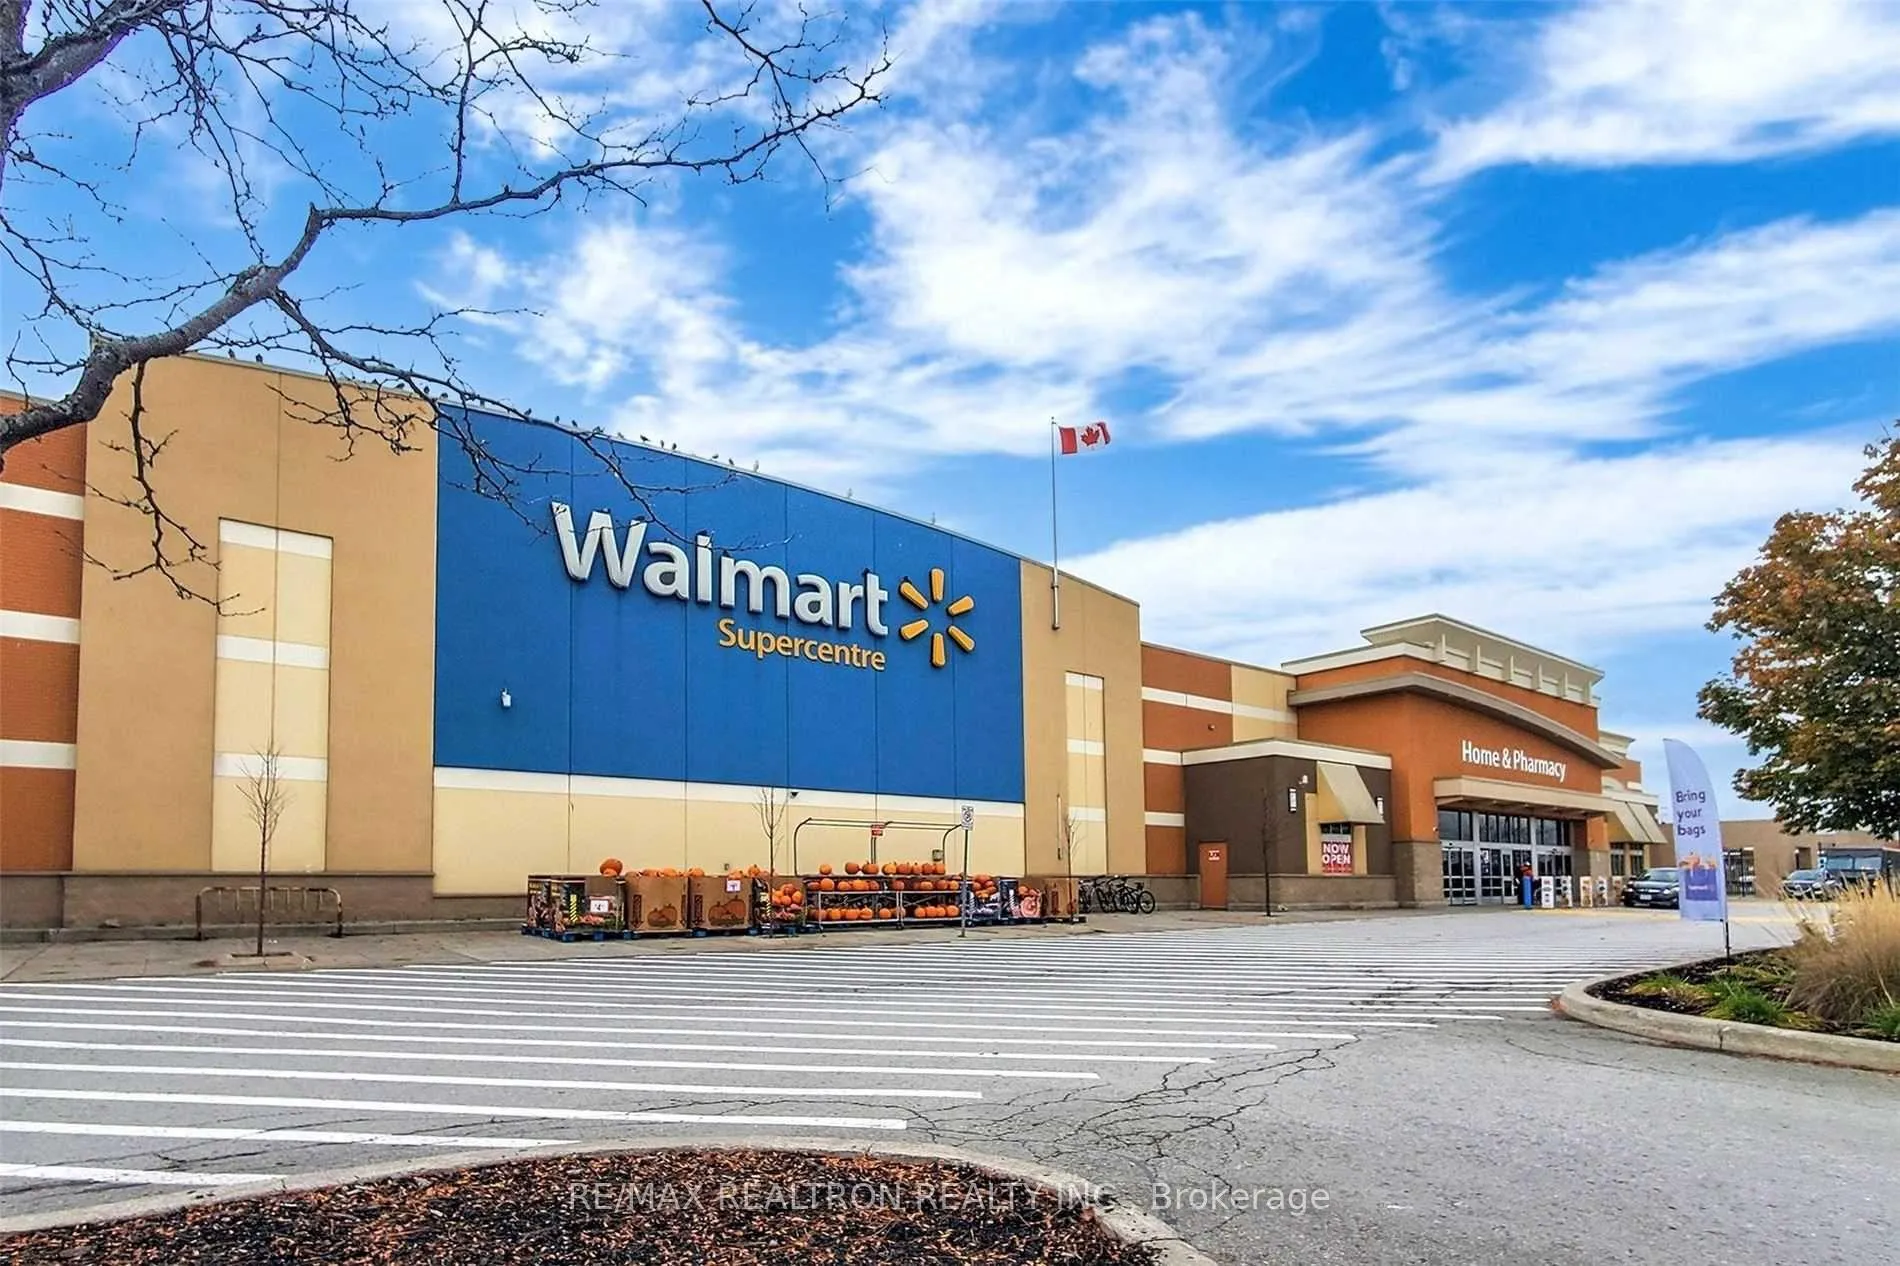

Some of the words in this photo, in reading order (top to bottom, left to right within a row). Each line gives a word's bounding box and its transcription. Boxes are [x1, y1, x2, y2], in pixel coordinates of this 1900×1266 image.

[552, 501, 889, 636] Walmart
[718, 618, 887, 672] Supercentre
[1462, 739, 1501, 768] Home
[1501, 747, 1512, 769] &
[1513, 749, 1567, 783] Pharmacy
[1675, 789, 1706, 803] Bring
[1677, 807, 1703, 823] your
[1677, 824, 1707, 839] bags
[1323, 843, 1349, 853] NOW
[1322, 854, 1350, 864] OPEN
